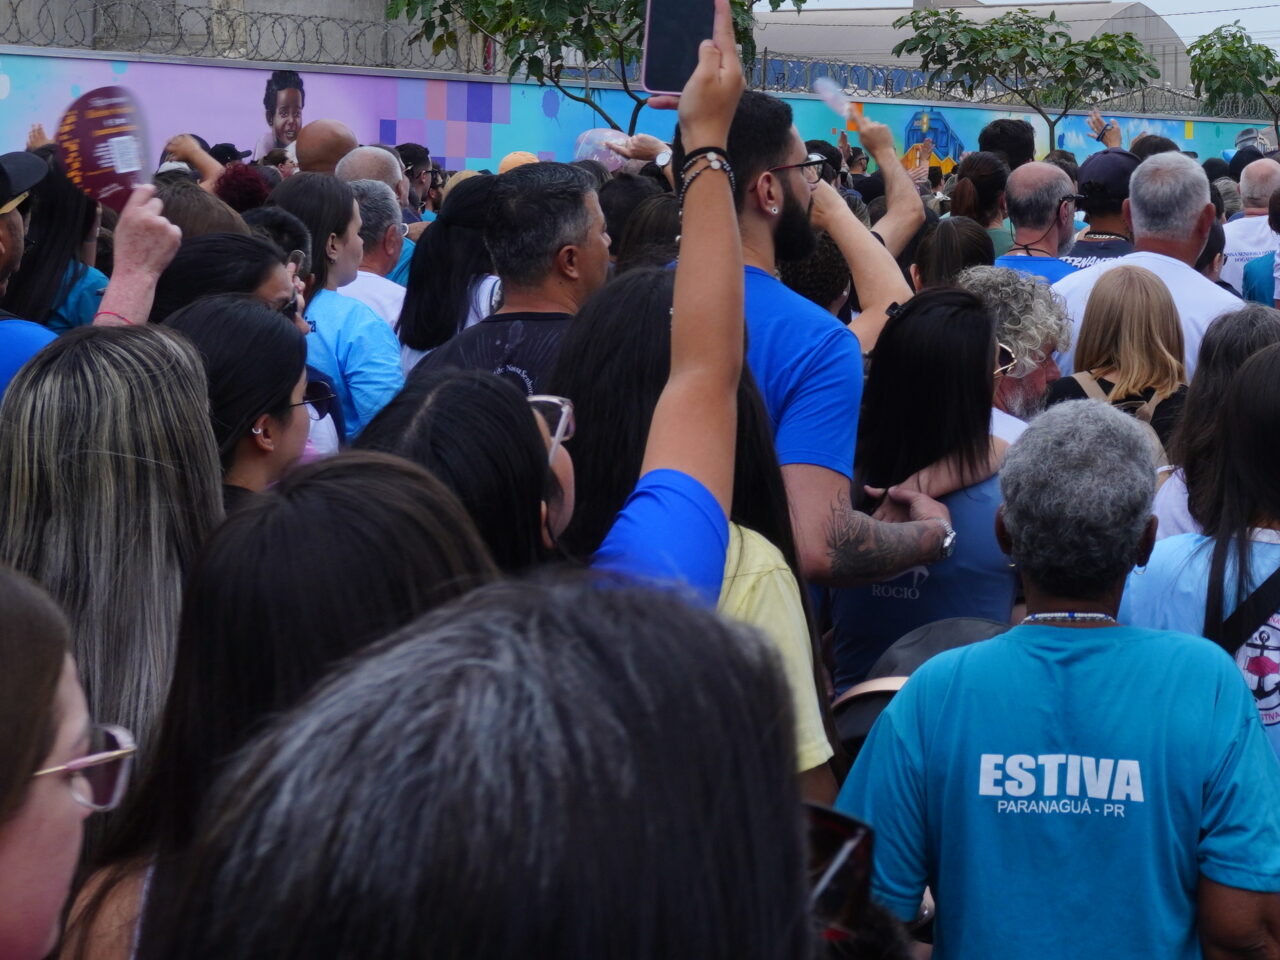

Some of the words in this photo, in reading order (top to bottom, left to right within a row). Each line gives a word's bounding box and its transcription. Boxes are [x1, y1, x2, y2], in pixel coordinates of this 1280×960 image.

[871, 584, 920, 600] ROCIO
[979, 753, 1145, 803] ESTIVA
[997, 798, 1092, 815] PARANAGUÁ
[1103, 803, 1126, 818] PR
